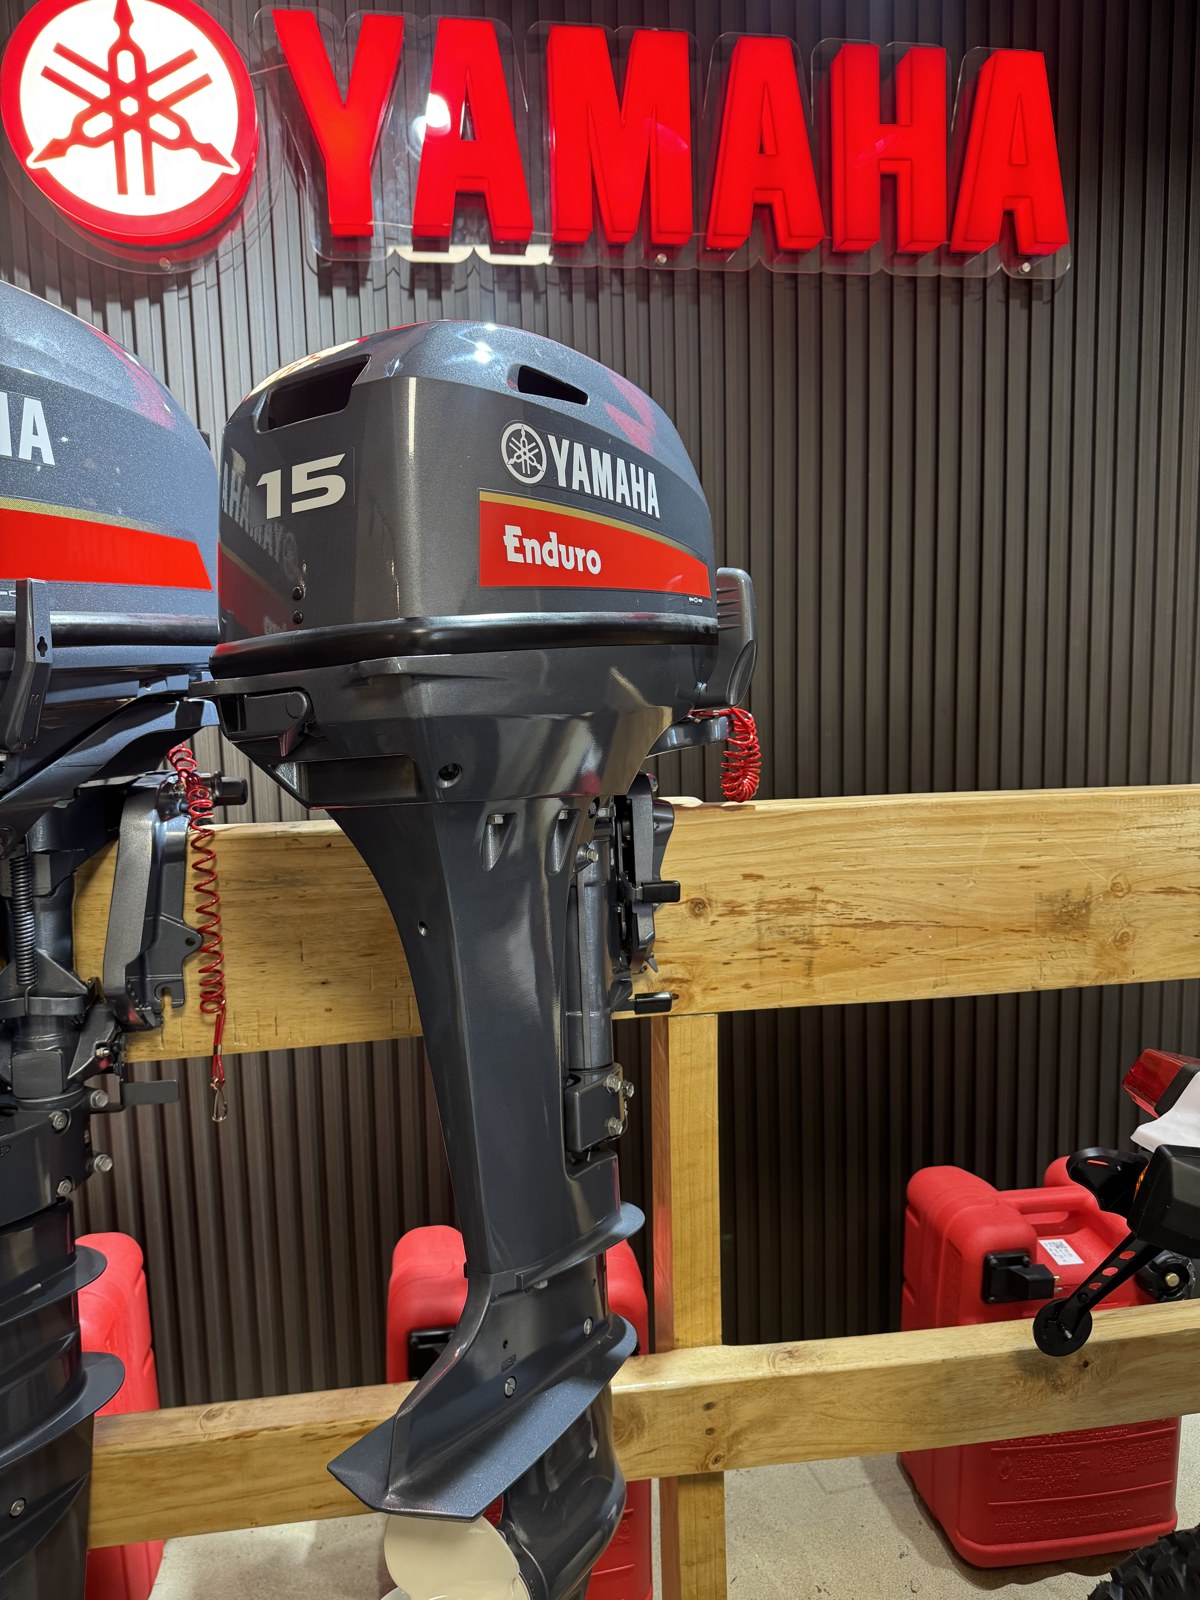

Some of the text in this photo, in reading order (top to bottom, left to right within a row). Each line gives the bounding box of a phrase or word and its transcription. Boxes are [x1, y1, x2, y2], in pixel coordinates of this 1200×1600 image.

[272, 9, 1070, 255] YAMAHA
[256, 453, 346, 520] 15
[547, 434, 661, 519] YAMAHA
[503, 524, 602, 575] Enduro
